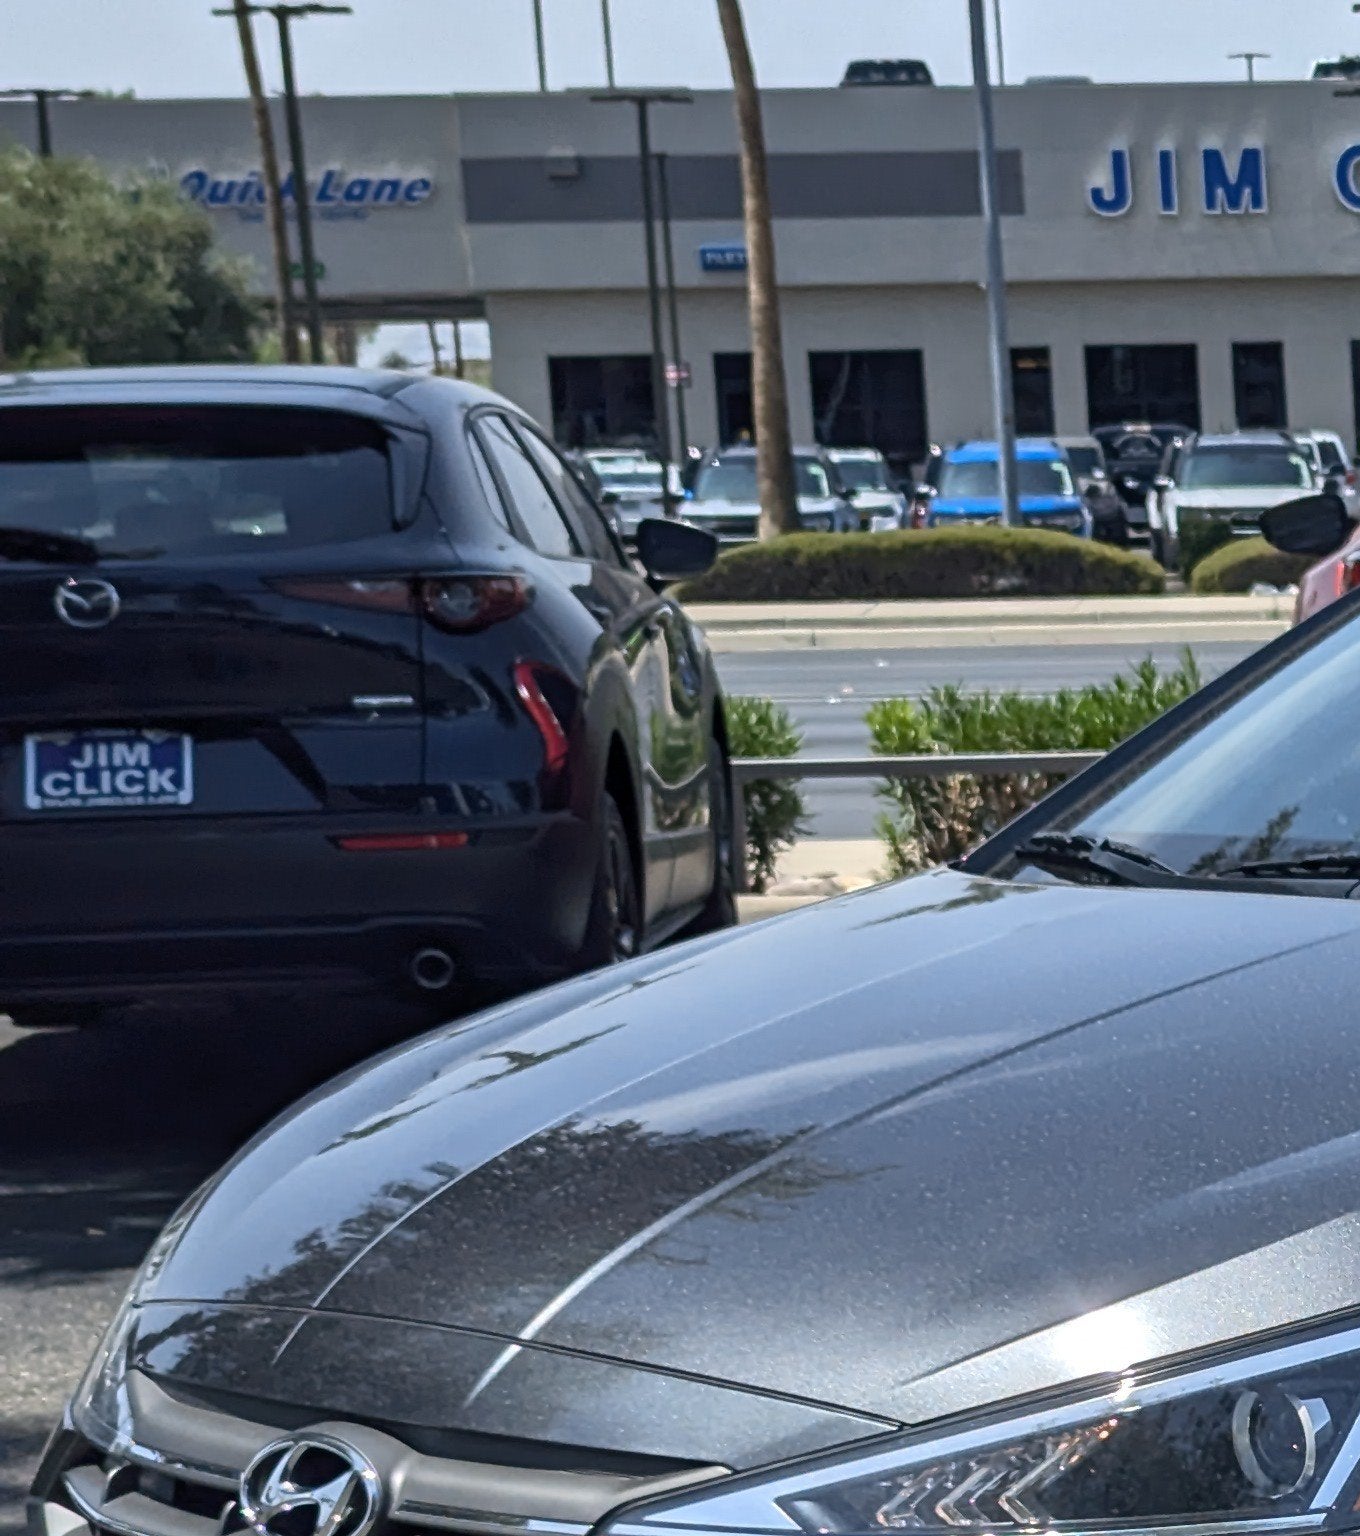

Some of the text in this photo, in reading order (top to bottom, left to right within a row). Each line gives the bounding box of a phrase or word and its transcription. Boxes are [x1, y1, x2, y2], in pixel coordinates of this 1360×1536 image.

[315, 168, 432, 203] Lane
[1090, 148, 1265, 214] JIM
[69, 742, 151, 768] JIM
[41, 767, 177, 796] CLICK
